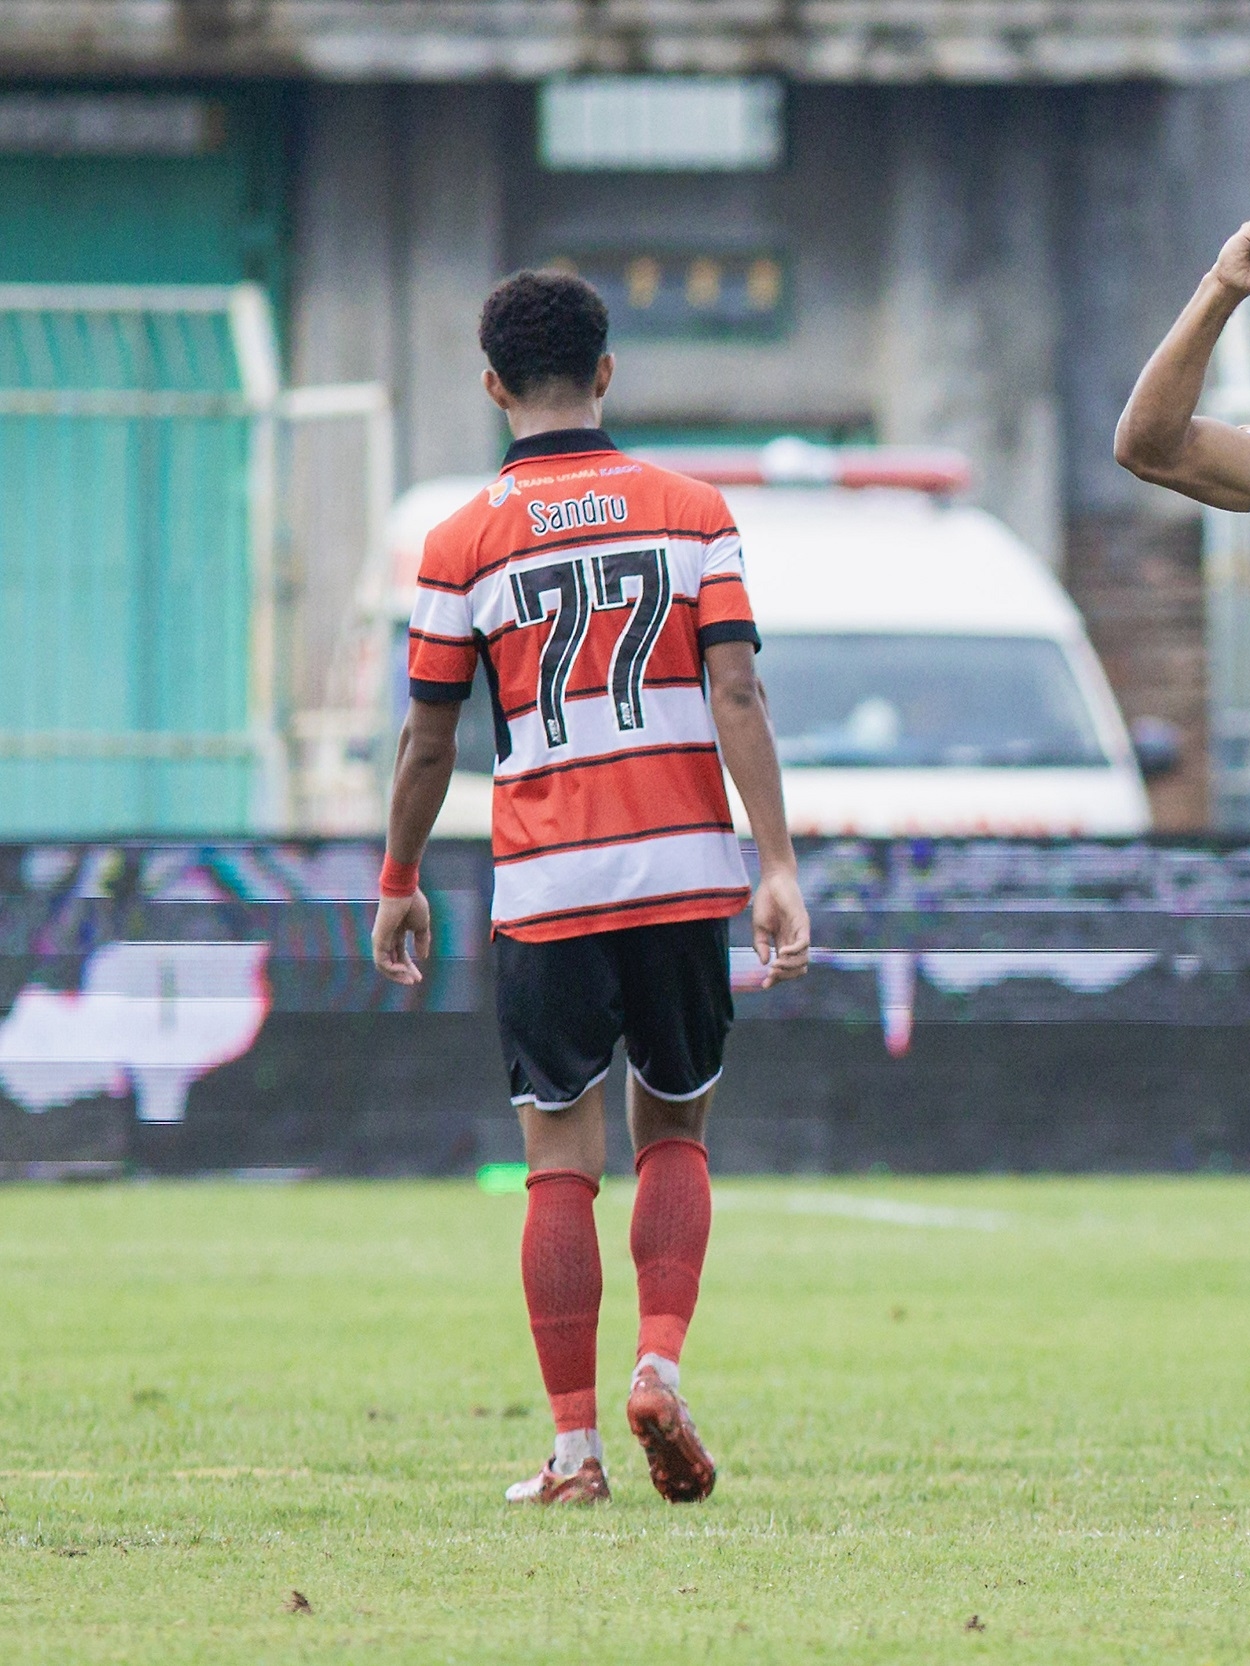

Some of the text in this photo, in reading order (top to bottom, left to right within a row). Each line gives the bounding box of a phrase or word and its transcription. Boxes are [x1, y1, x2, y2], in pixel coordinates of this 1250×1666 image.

[517, 476, 554, 488] TRANS
[556, 469, 598, 482] UTAMA
[508, 547, 673, 750] 77
